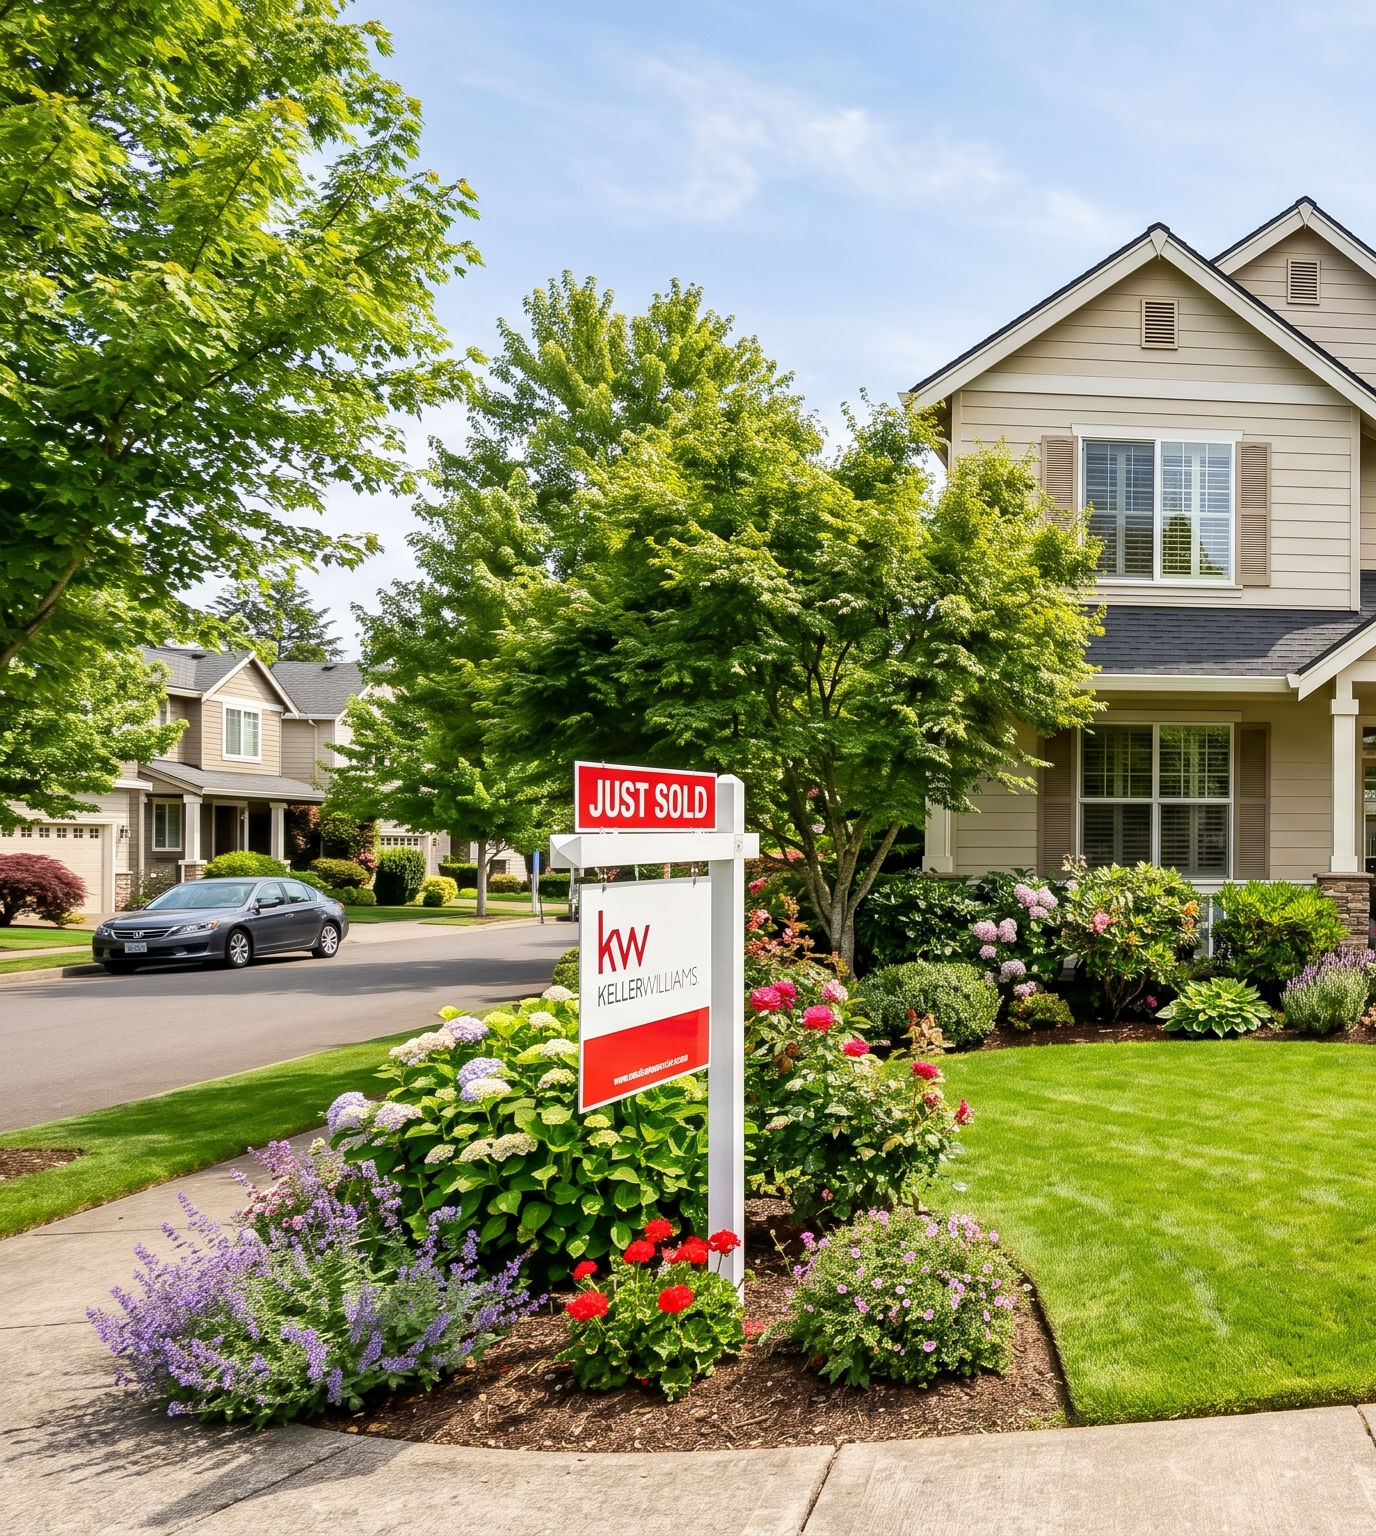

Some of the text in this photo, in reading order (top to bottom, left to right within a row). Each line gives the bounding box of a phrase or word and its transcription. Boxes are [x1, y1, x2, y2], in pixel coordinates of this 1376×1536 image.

[589, 779, 708, 819] JUST SOLD
[598, 910, 650, 975] kw
